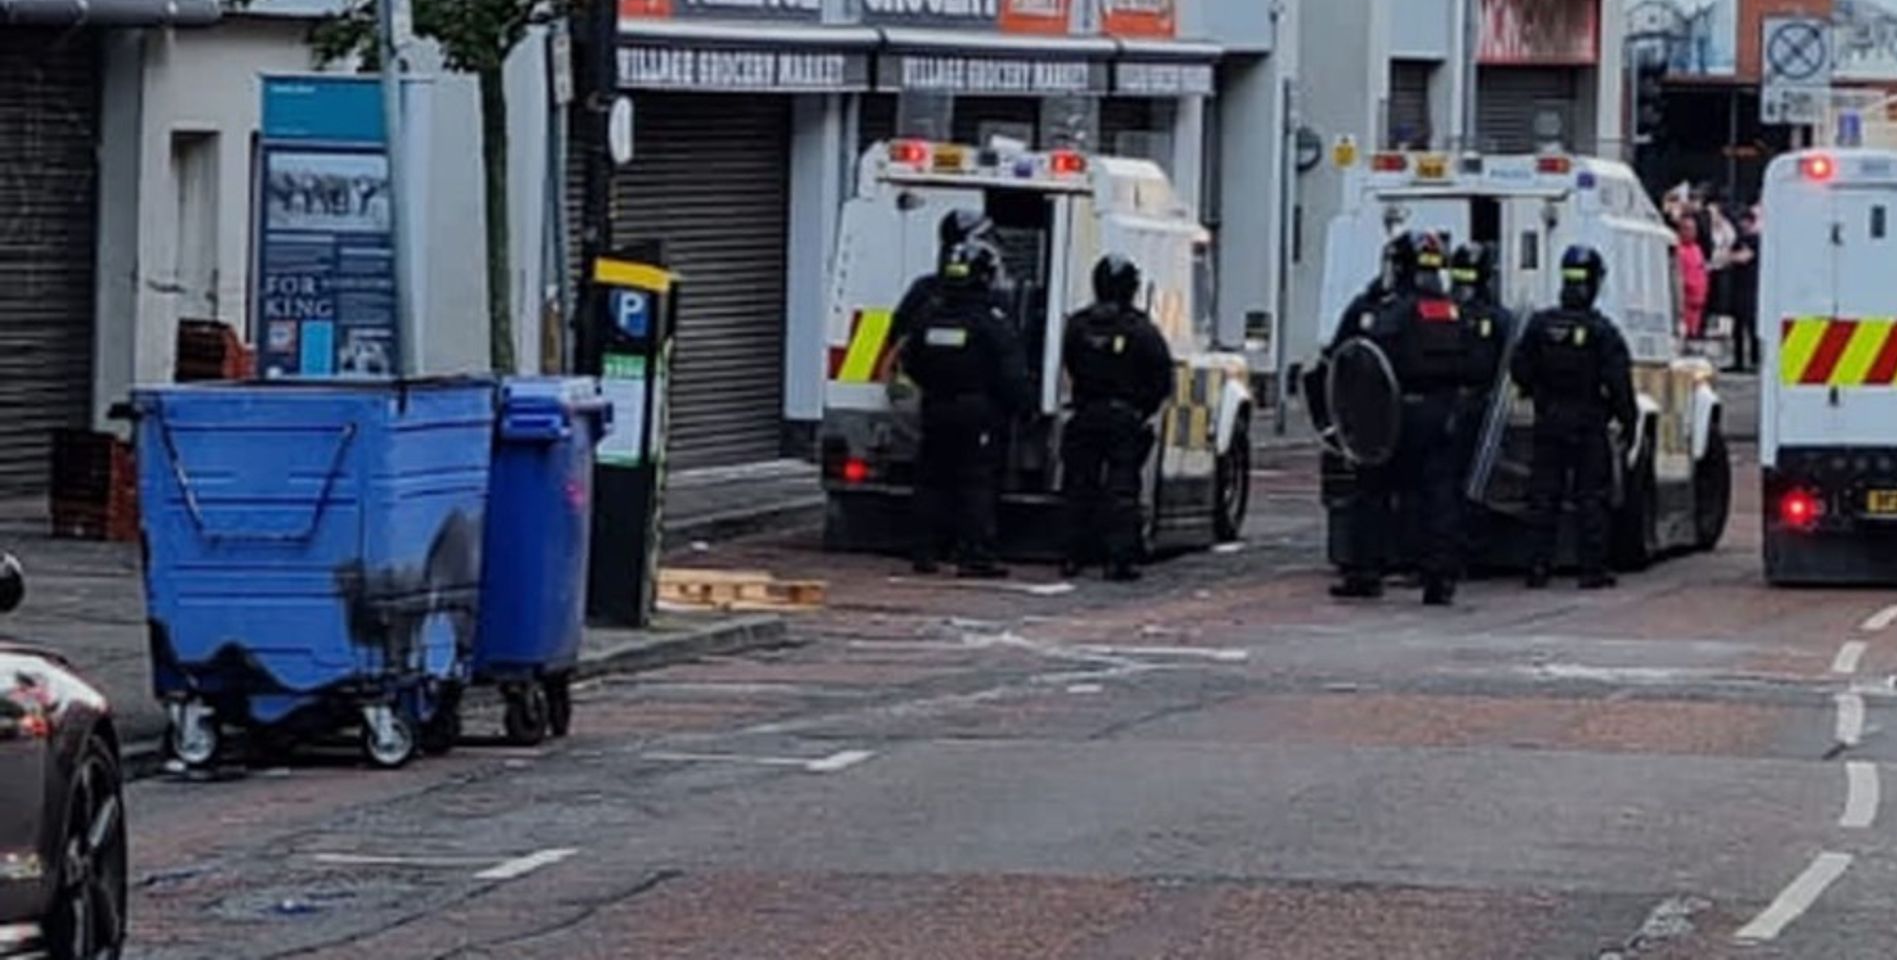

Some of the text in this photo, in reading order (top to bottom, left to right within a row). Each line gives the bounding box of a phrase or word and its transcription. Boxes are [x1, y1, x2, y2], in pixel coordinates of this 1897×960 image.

[616, 48, 845, 85] VILLAGE GROCERY MARKET
[903, 57, 964, 88] VILLAGE
[967, 59, 1031, 90] GROCERY
[1034, 62, 1088, 91] MARKET
[265, 275, 316, 294] FOR
[264, 298, 334, 317] KING
[618, 290, 646, 329] P
